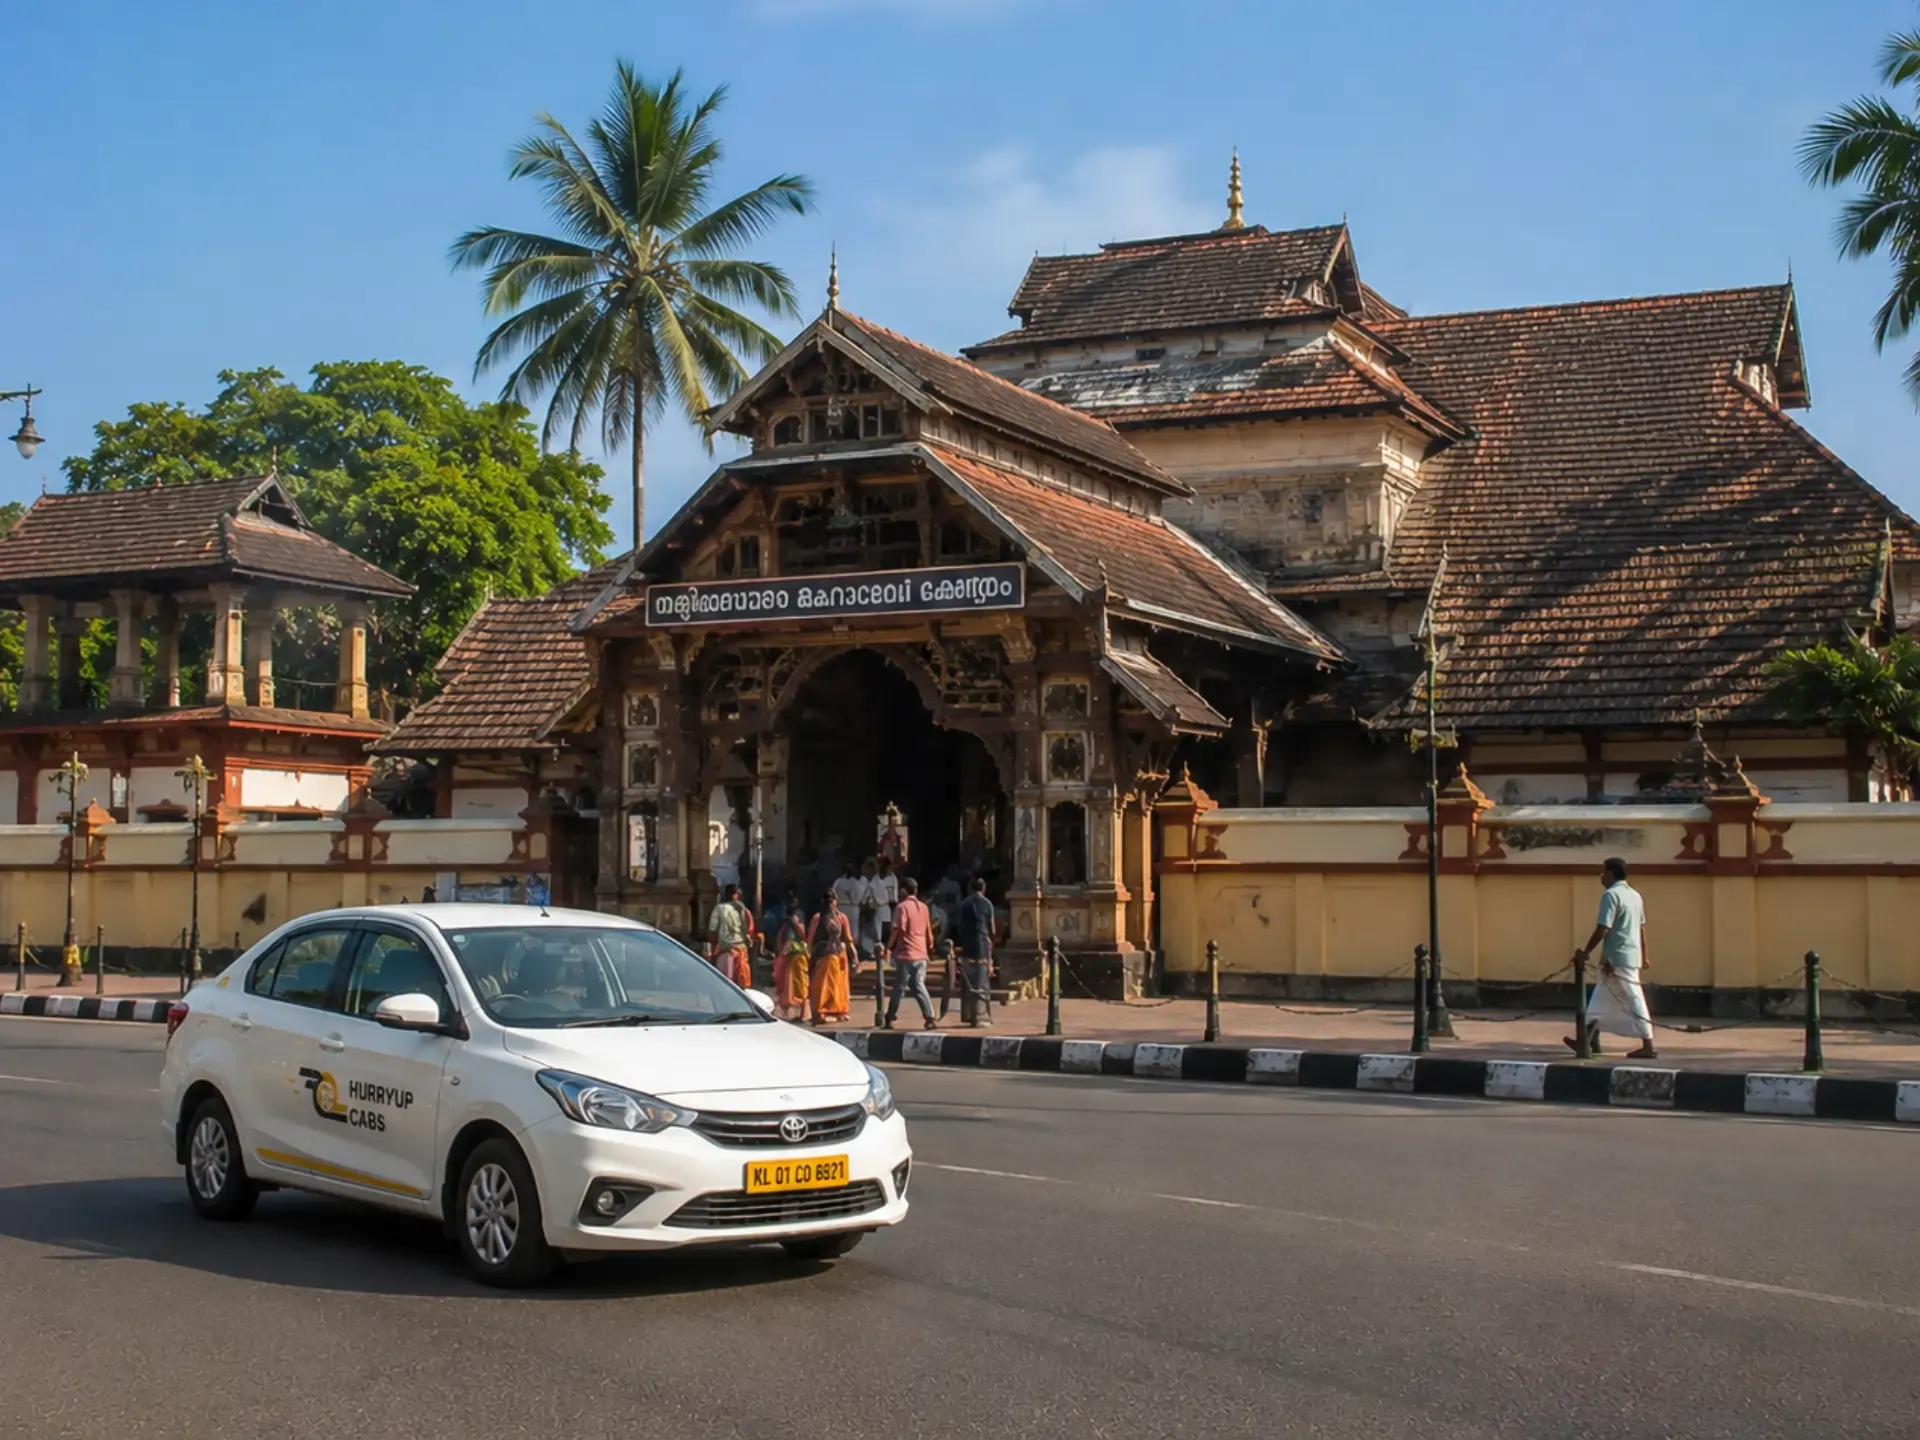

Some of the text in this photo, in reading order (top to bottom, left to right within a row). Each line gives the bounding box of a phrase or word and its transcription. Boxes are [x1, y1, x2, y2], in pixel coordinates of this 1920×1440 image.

[348, 1080, 414, 1110] HURRYUP
[348, 1108, 386, 1132] CABS
[753, 1167, 771, 1186] KL
[775, 1166, 790, 1185] 01
